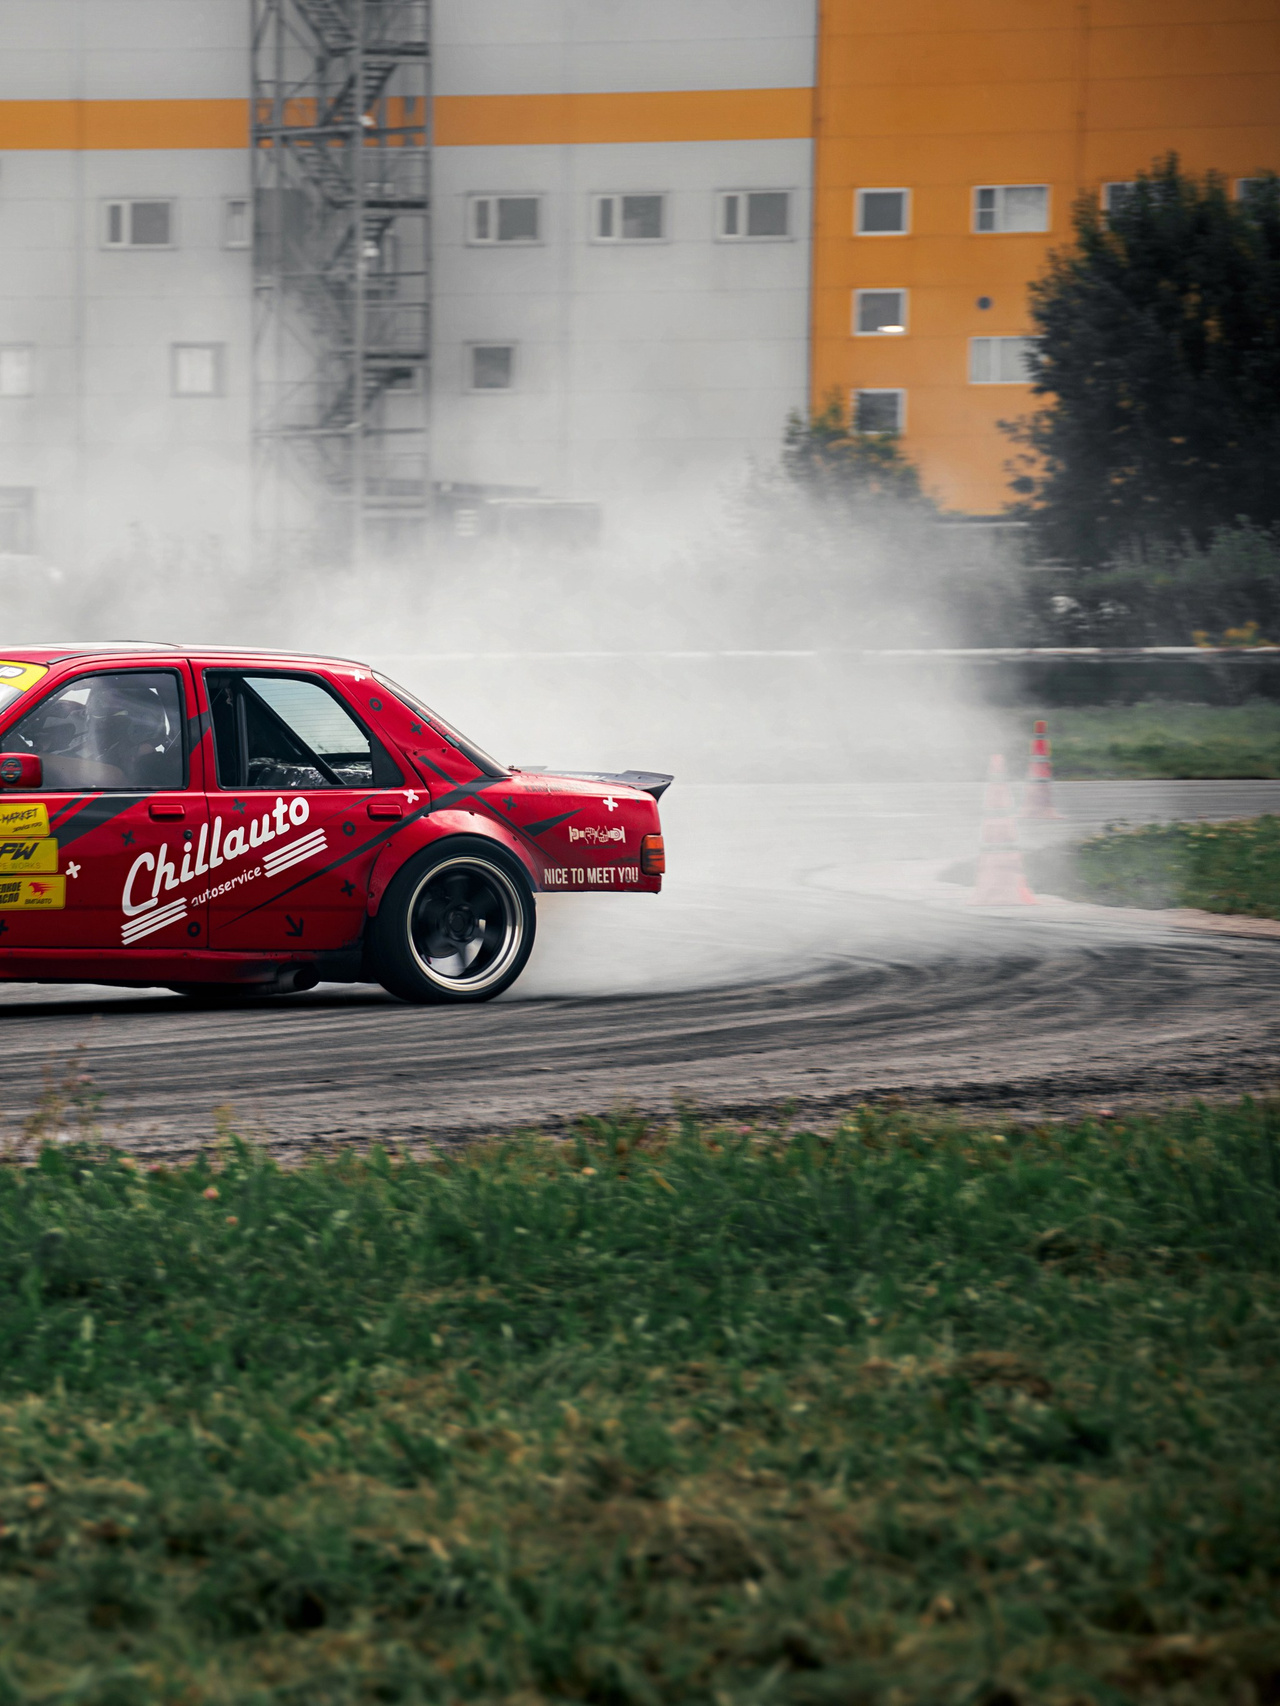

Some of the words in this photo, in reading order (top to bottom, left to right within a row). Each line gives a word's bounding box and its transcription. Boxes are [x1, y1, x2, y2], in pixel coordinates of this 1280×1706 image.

[121, 796, 310, 917] Chillauto
[543, 868, 569, 885] NICE
[570, 867, 585, 884] TO
[586, 867, 616, 884] MEET
[617, 866, 639, 883] YOU
[190, 866, 262, 907] autoservice
